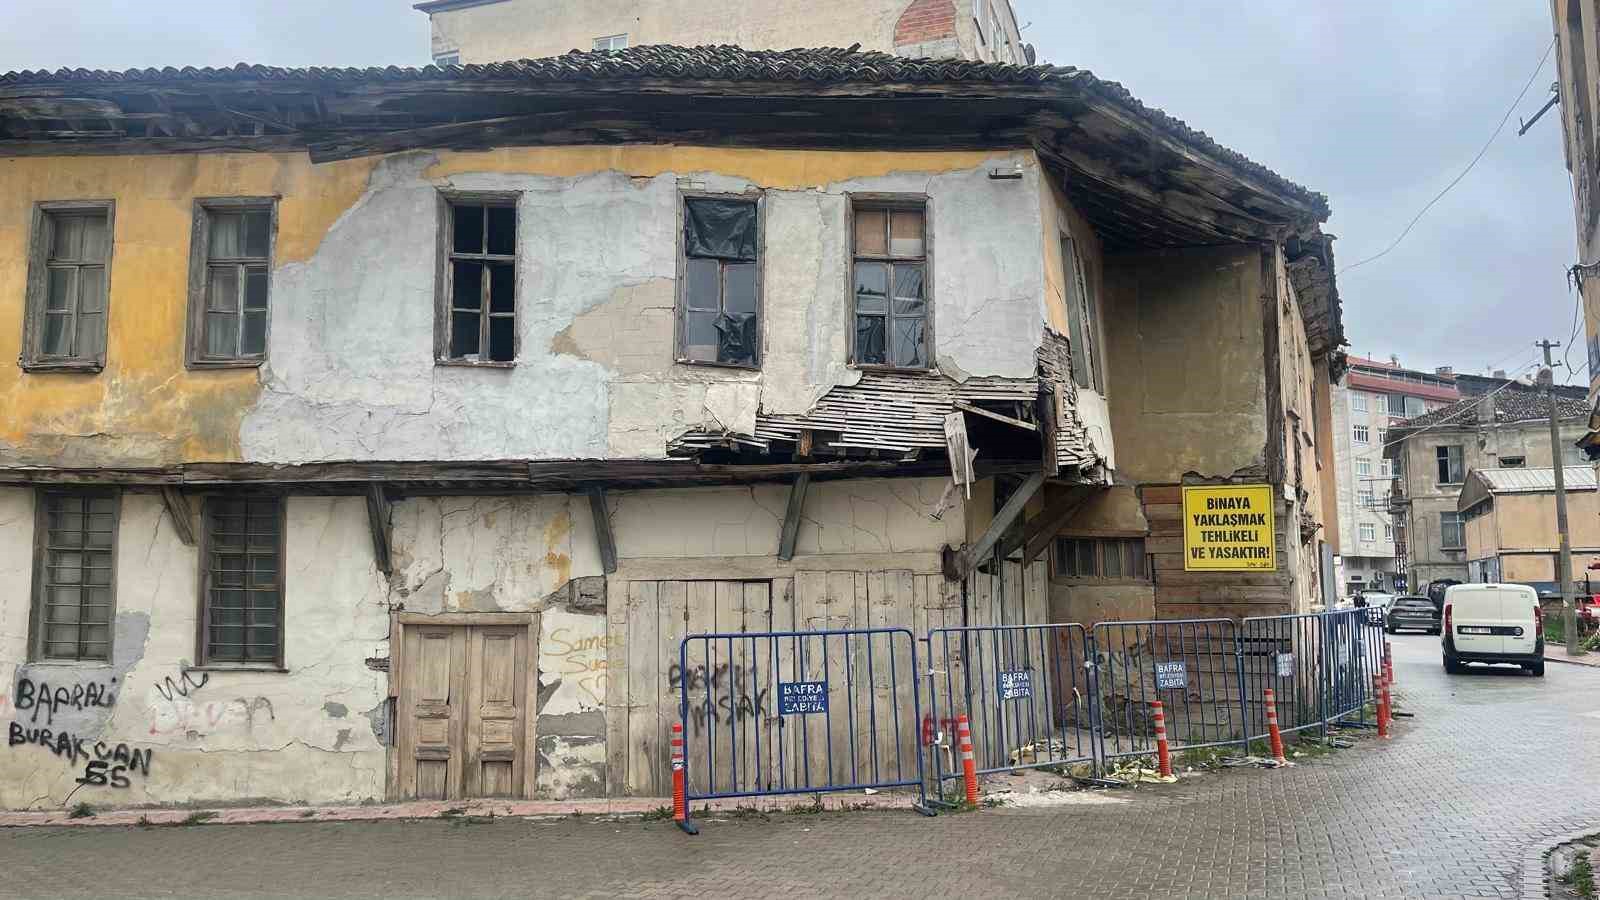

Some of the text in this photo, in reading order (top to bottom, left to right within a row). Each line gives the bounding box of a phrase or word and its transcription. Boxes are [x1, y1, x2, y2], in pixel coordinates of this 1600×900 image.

[1206, 497, 1251, 510] BİNAYA
[1193, 513, 1266, 527] YAKLAŞMAK
[1200, 530, 1258, 543] TEHLİKELİ
[1191, 546, 1270, 560] VE YASAKTIR!
[1158, 664, 1184, 673] BAFRA
[1002, 671, 1029, 681] BAFRA
[1160, 679, 1185, 687] ZABITA
[784, 684, 823, 695] BAFRA
[1003, 688, 1030, 699] ZABITA
[784, 702, 825, 712] ZABITA
[9, 721, 152, 776] BURAK CAN
